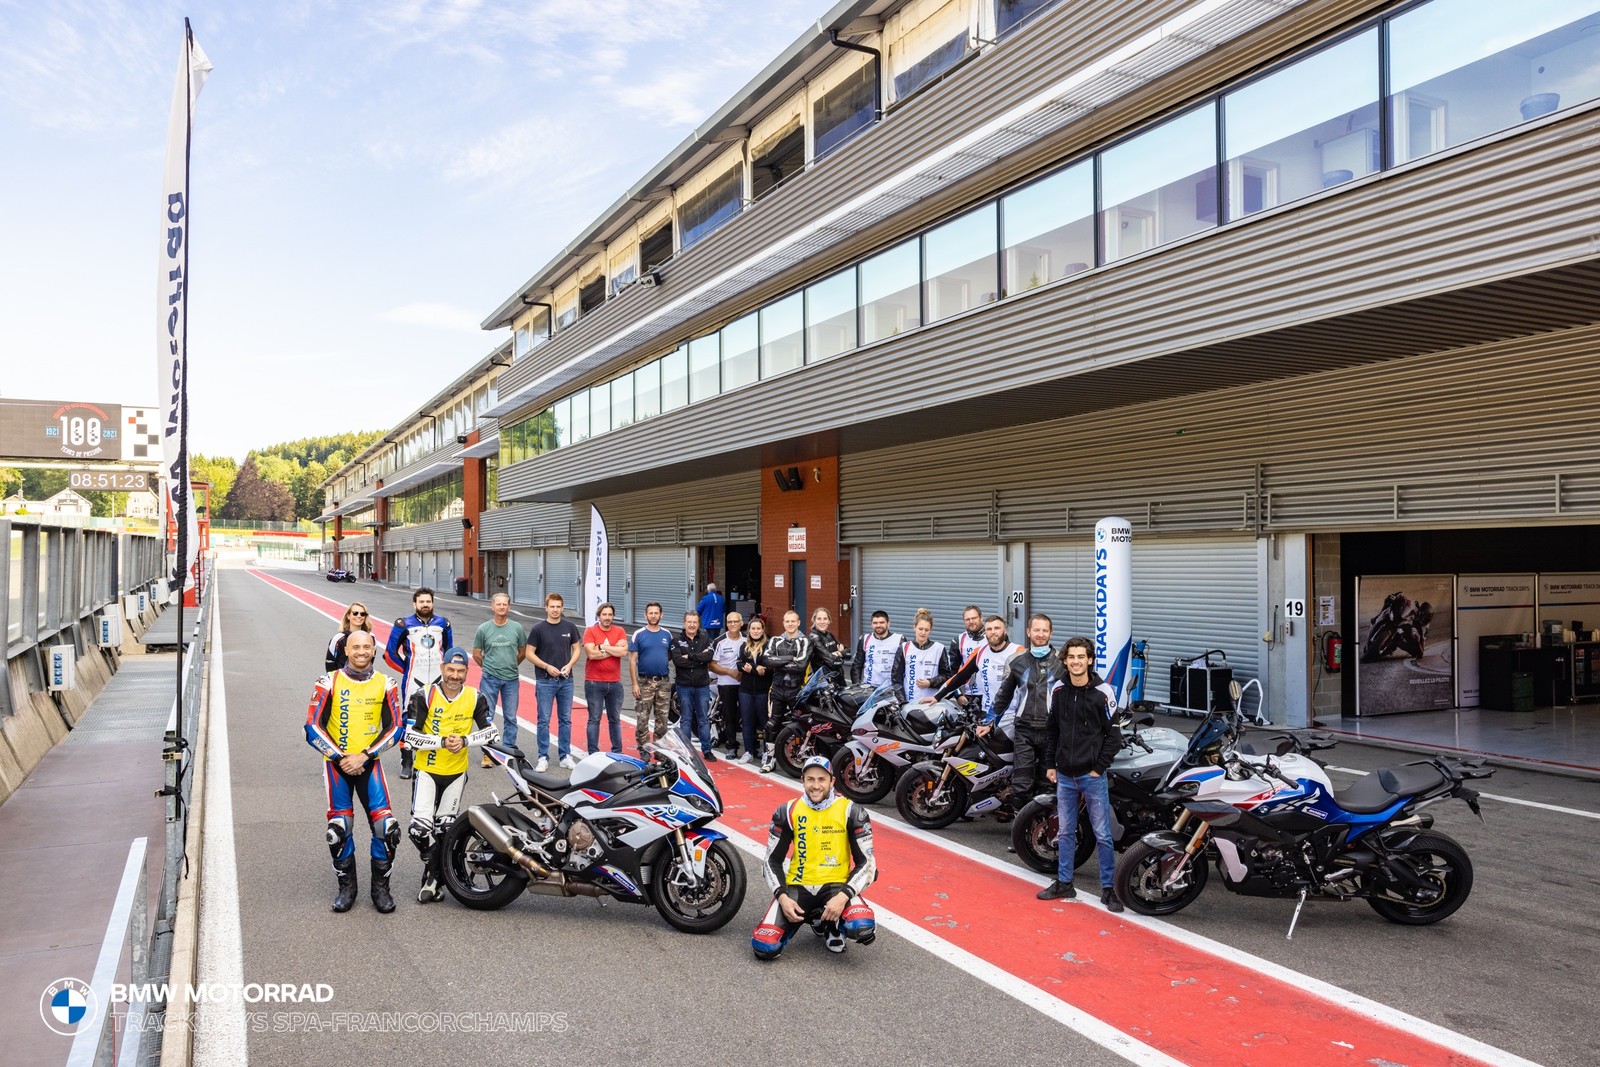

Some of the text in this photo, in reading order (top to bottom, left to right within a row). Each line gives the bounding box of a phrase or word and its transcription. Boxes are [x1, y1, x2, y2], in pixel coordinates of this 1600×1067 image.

[45, 427, 59, 436] 1921
[60, 416, 101, 446] 100
[70, 473, 145, 488] 08:51:23
[1111, 527, 1131, 535] BMW
[850, 586, 857, 595] 21
[1013, 592, 1023, 604] 20
[1096, 548, 1108, 672] TRACKDAYS
[1286, 601, 1304, 616] 19
[908, 654, 917, 701] TRACKDAYS
[982, 658, 990, 709] TRACKDAYS
[338, 689, 350, 751] RACKDAYS
